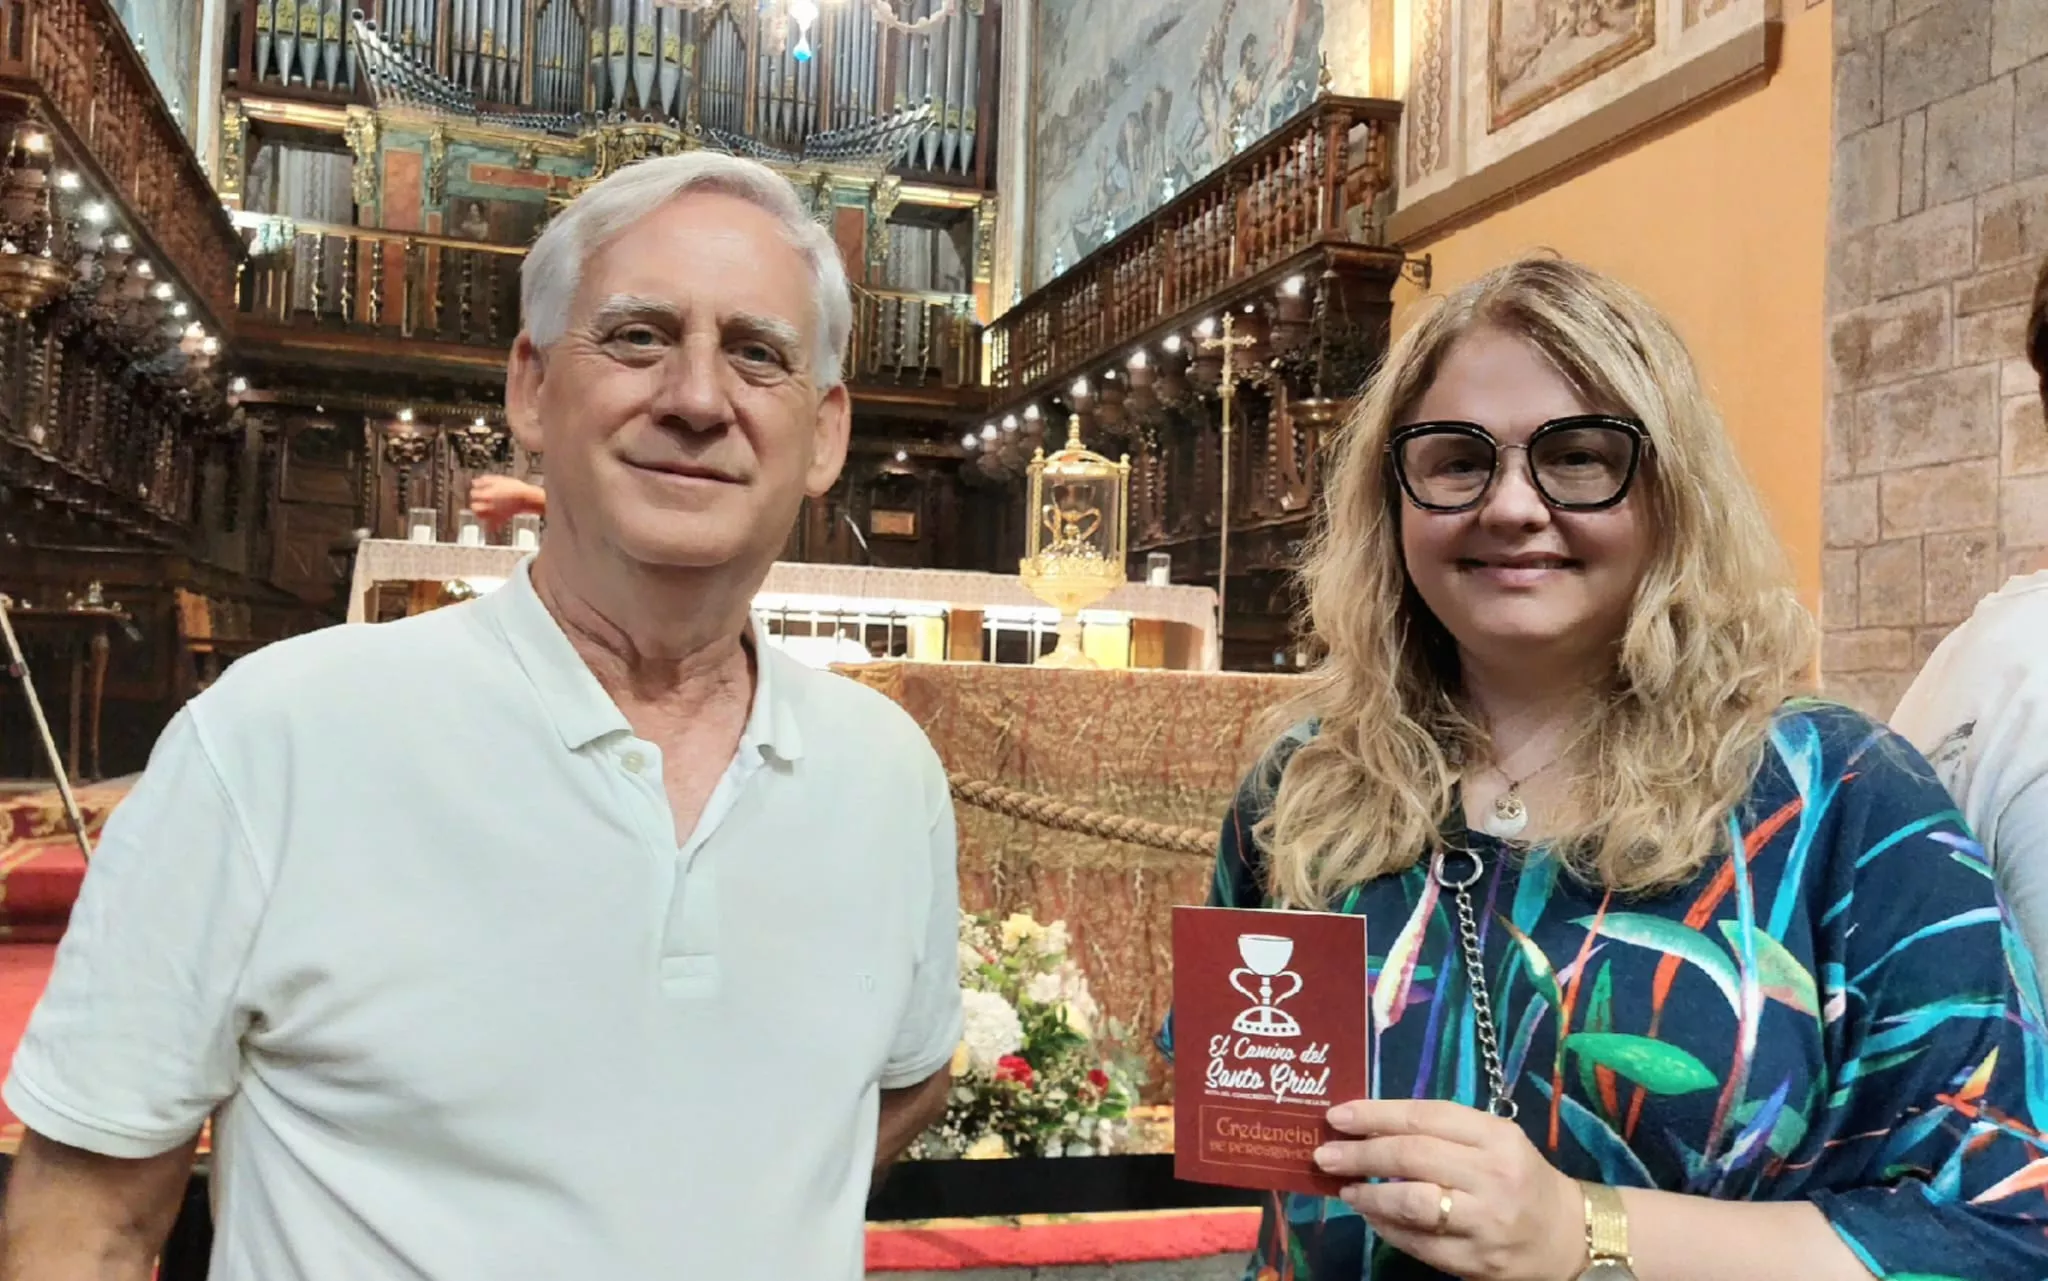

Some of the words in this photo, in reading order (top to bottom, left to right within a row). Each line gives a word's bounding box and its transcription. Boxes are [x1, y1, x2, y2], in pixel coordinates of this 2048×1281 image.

[1208, 1034, 1231, 1057] El
[1234, 1036, 1296, 1061] Camino
[1299, 1041, 1330, 1064] del
[1205, 1057, 1264, 1089] Santo
[1270, 1063, 1331, 1104] Grial
[1216, 1116, 1319, 1145] Credencial
